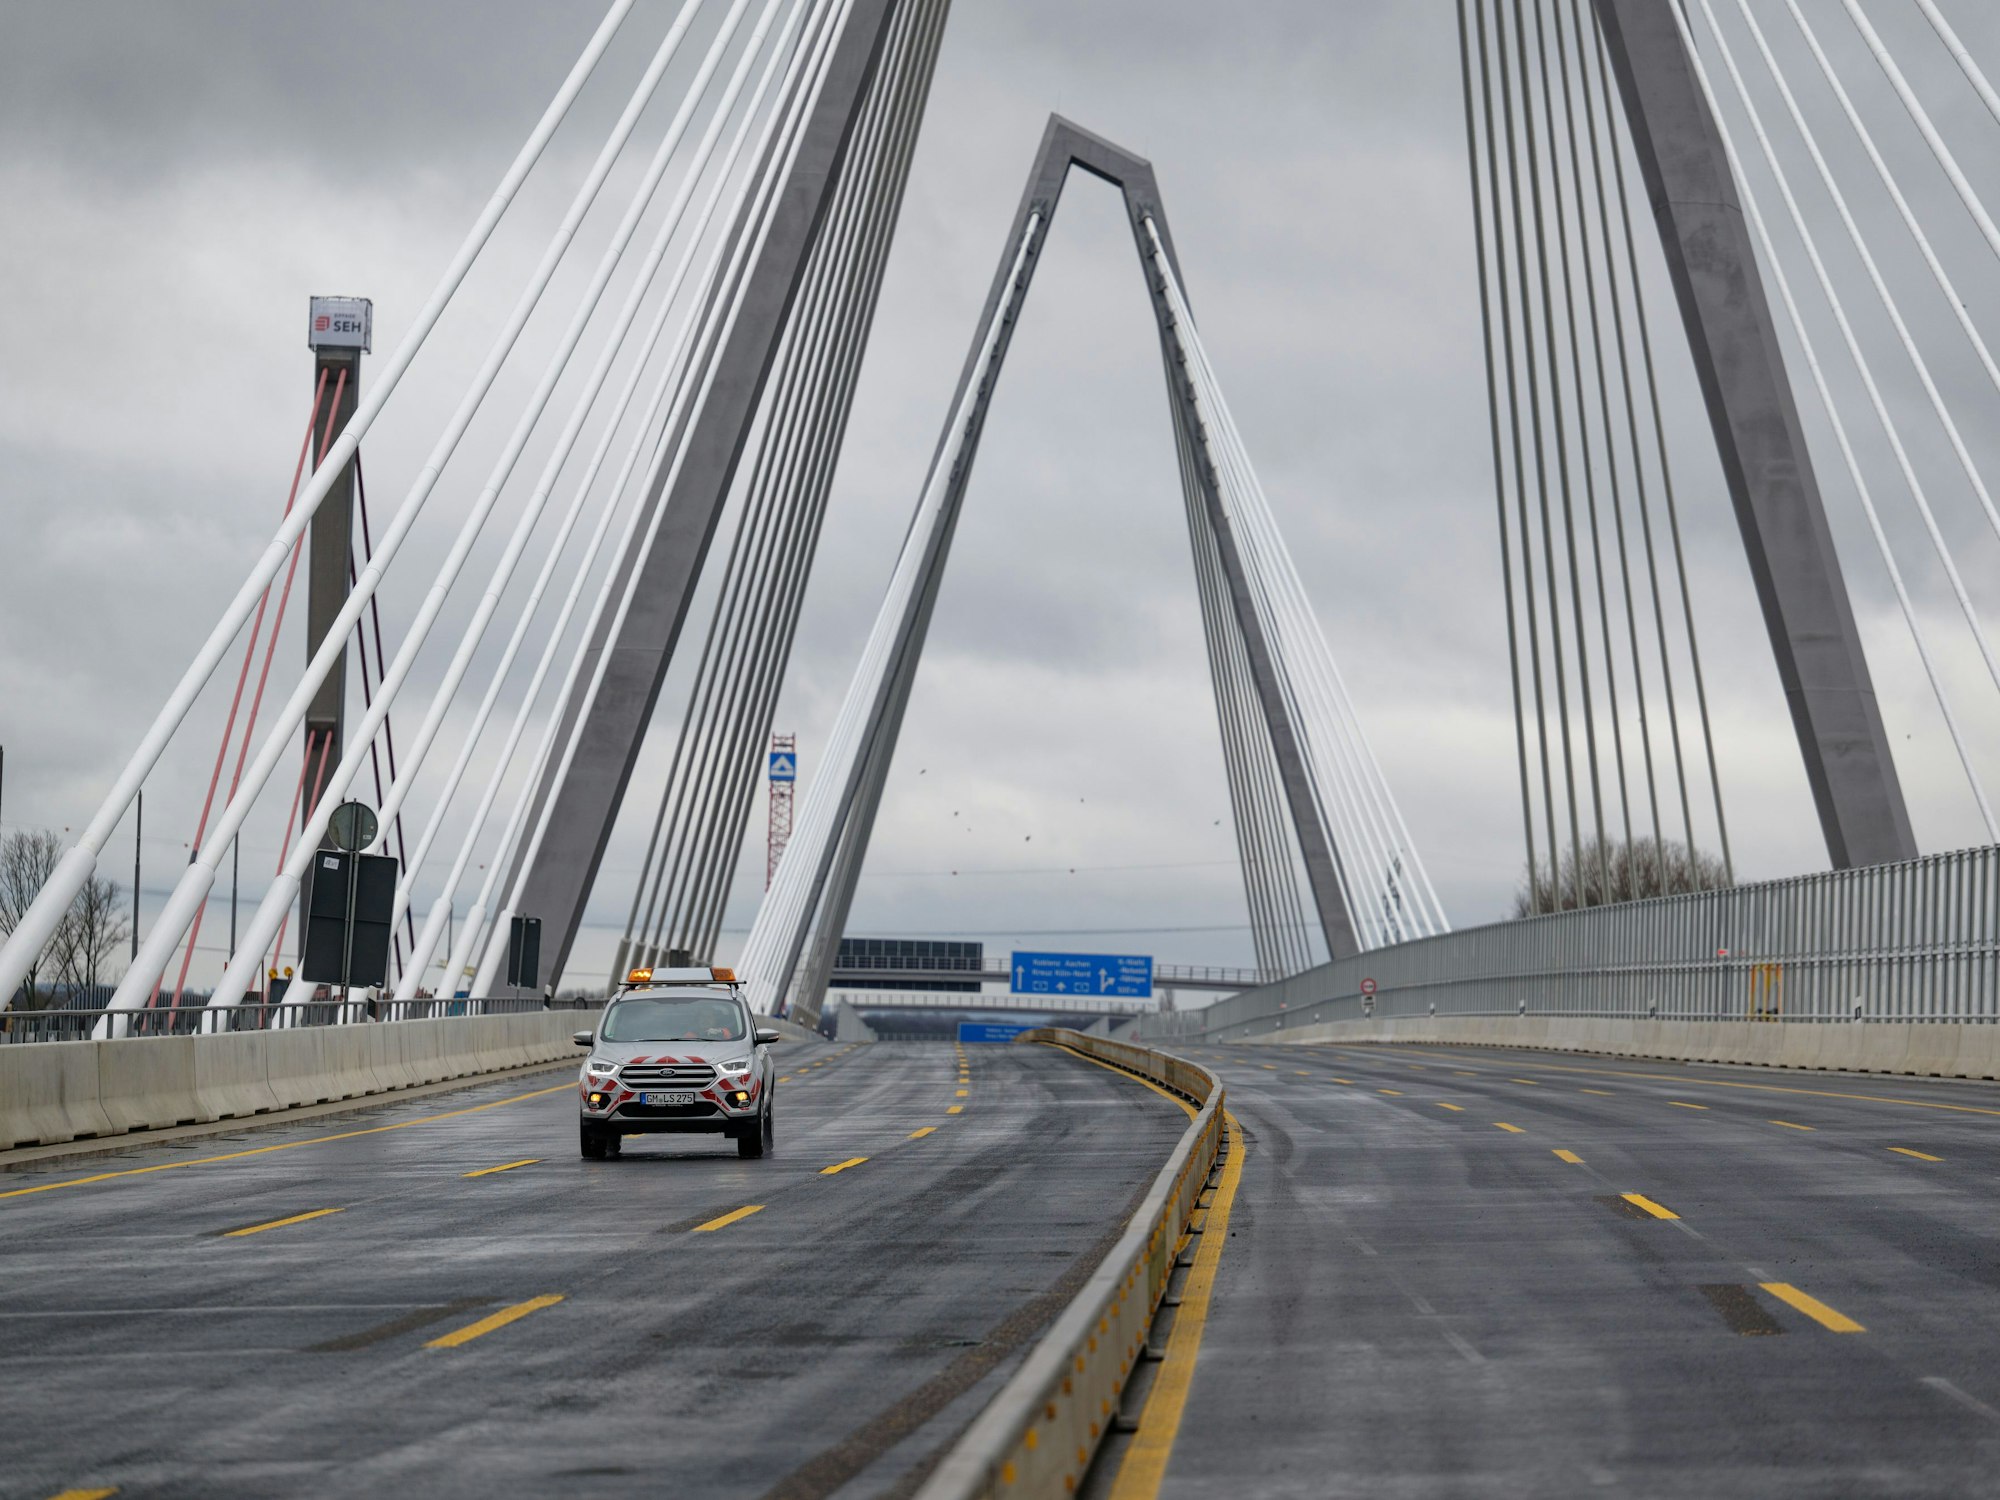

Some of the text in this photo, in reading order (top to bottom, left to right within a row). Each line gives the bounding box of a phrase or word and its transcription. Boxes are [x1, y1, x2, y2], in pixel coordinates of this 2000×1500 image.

[333, 320, 361, 333] SEH
[1064, 959, 1091, 968] Aachen
[676, 1094, 693, 1103] 275
